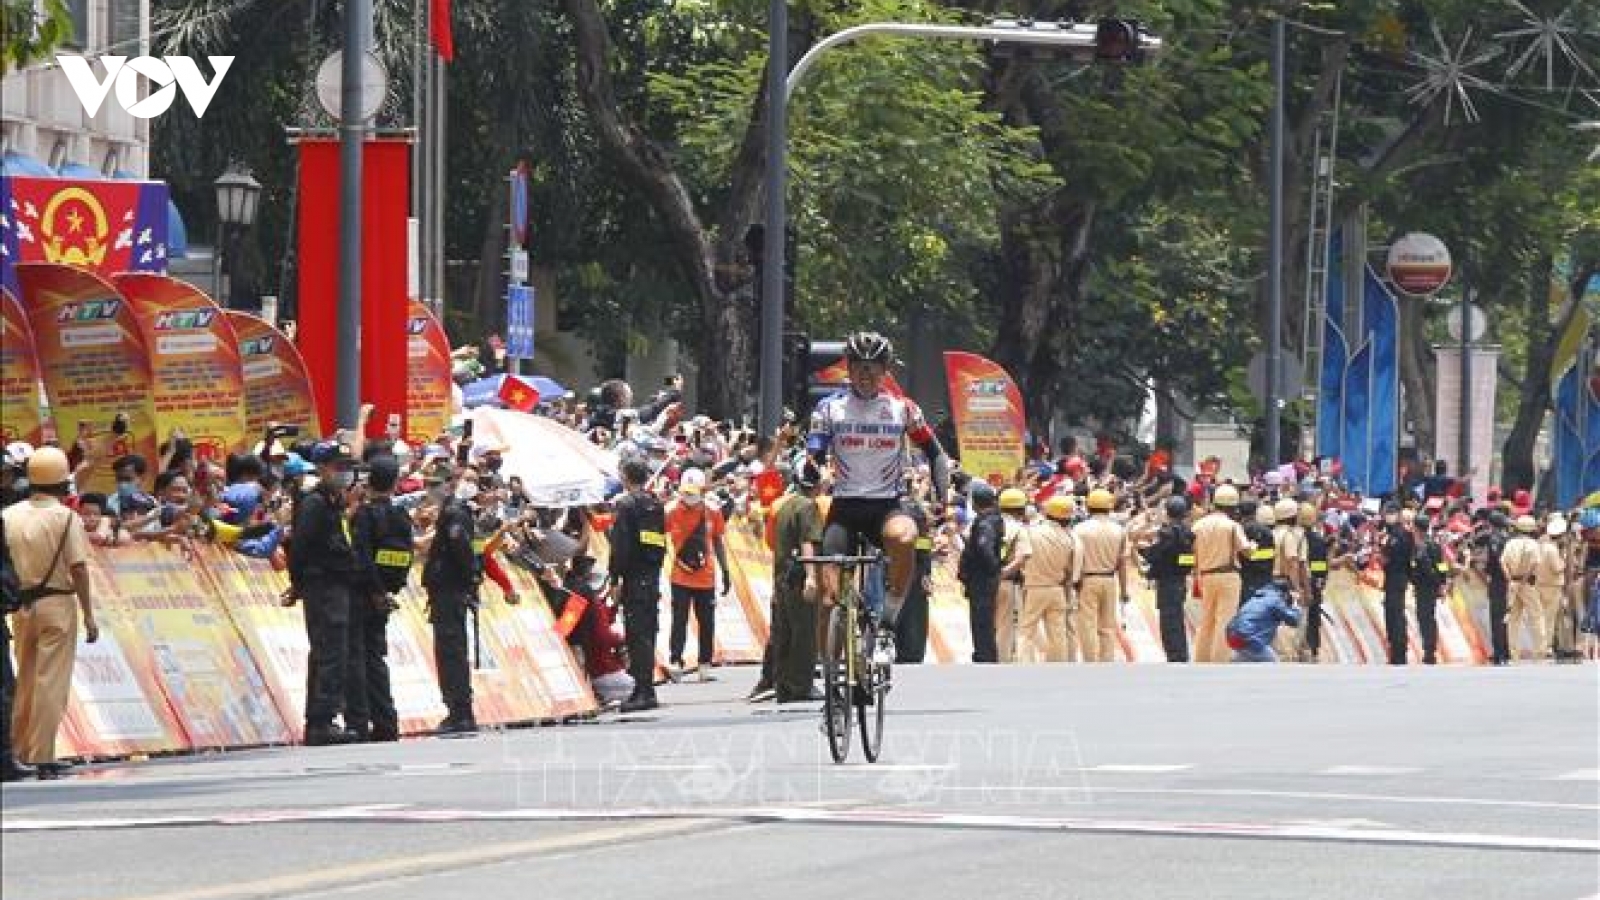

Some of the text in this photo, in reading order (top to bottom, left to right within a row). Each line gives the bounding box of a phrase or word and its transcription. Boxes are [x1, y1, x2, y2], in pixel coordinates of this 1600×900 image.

[58, 300, 121, 322] HTV
[155, 309, 216, 330] HTV
[239, 335, 274, 355] TV
[966, 379, 1008, 395] HTV
